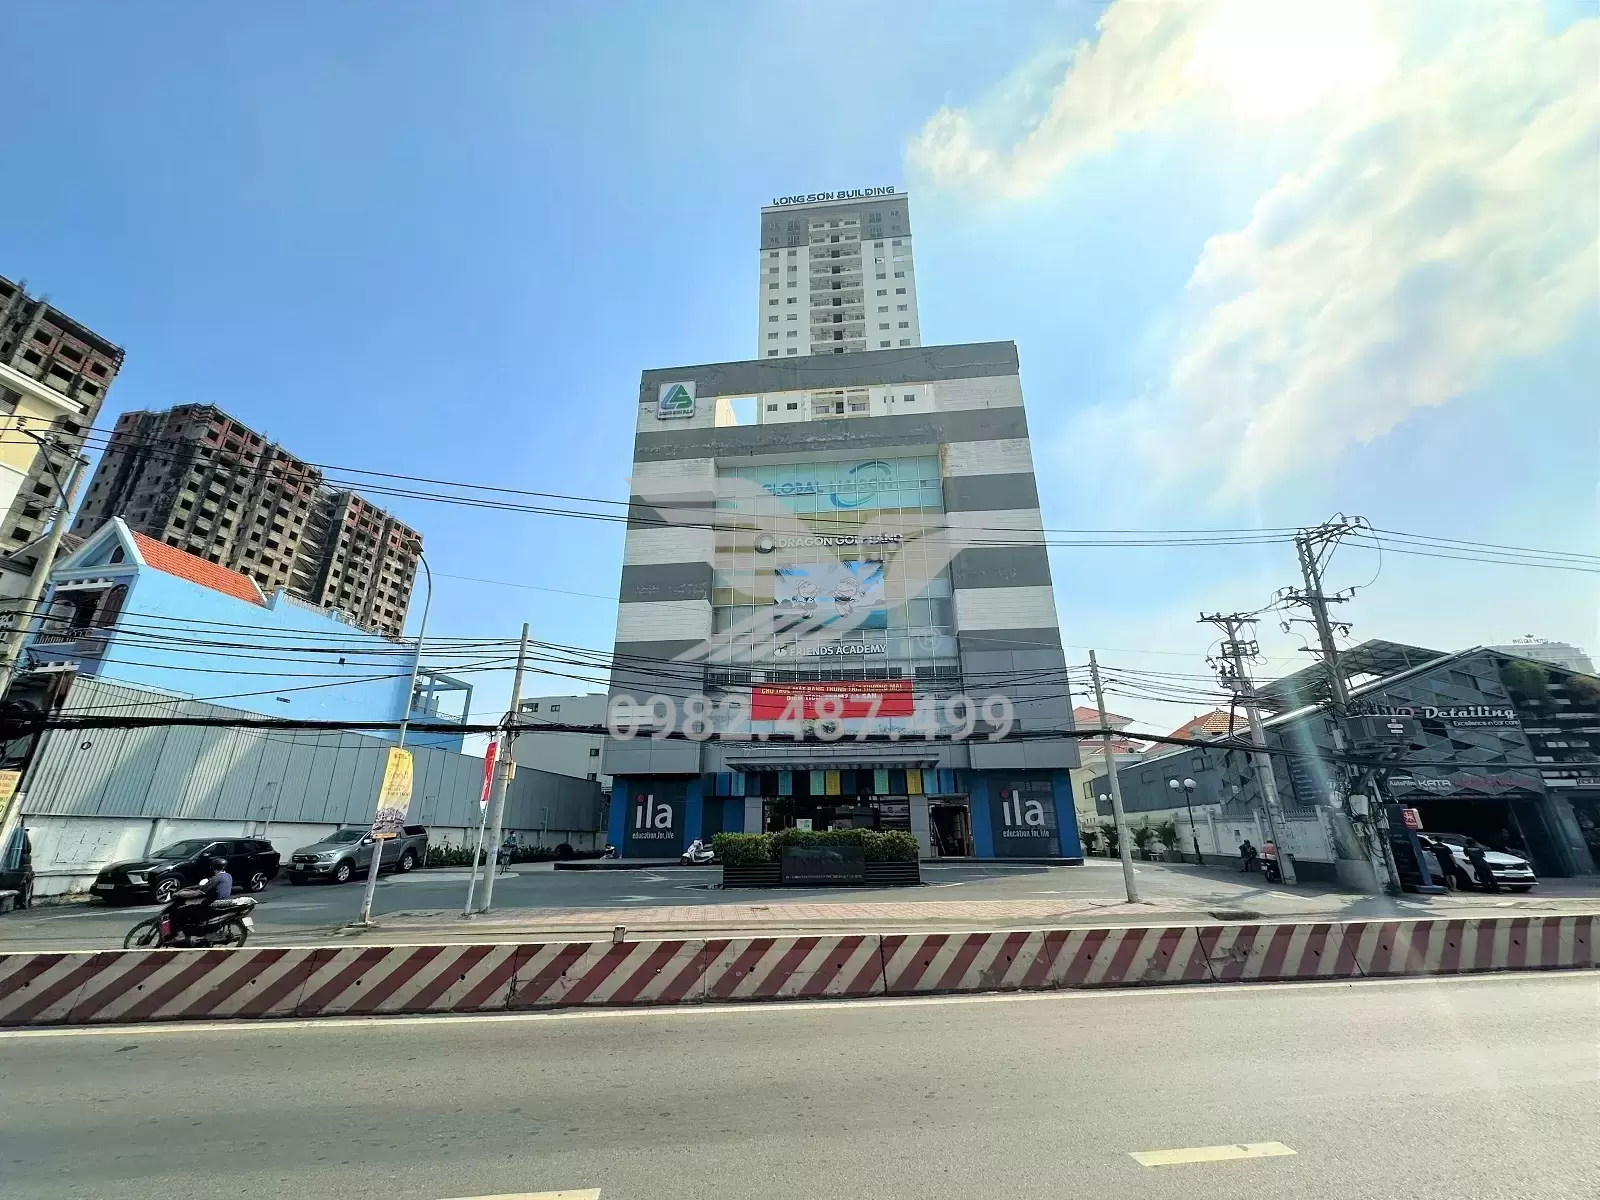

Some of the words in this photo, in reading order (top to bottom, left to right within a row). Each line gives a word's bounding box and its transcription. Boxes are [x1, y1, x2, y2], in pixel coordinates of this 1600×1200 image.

[772, 194, 805, 206] LONG
[836, 185, 895, 199] BUILDING
[777, 537, 833, 549] DRAGON
[790, 647, 833, 656] FRIENDS
[836, 645, 886, 655] ACADEMY
[1421, 706, 1518, 719] Detailing
[1417, 779, 1451, 787] KATA
[635, 794, 673, 829] ila
[1000, 789, 1045, 826] ila
